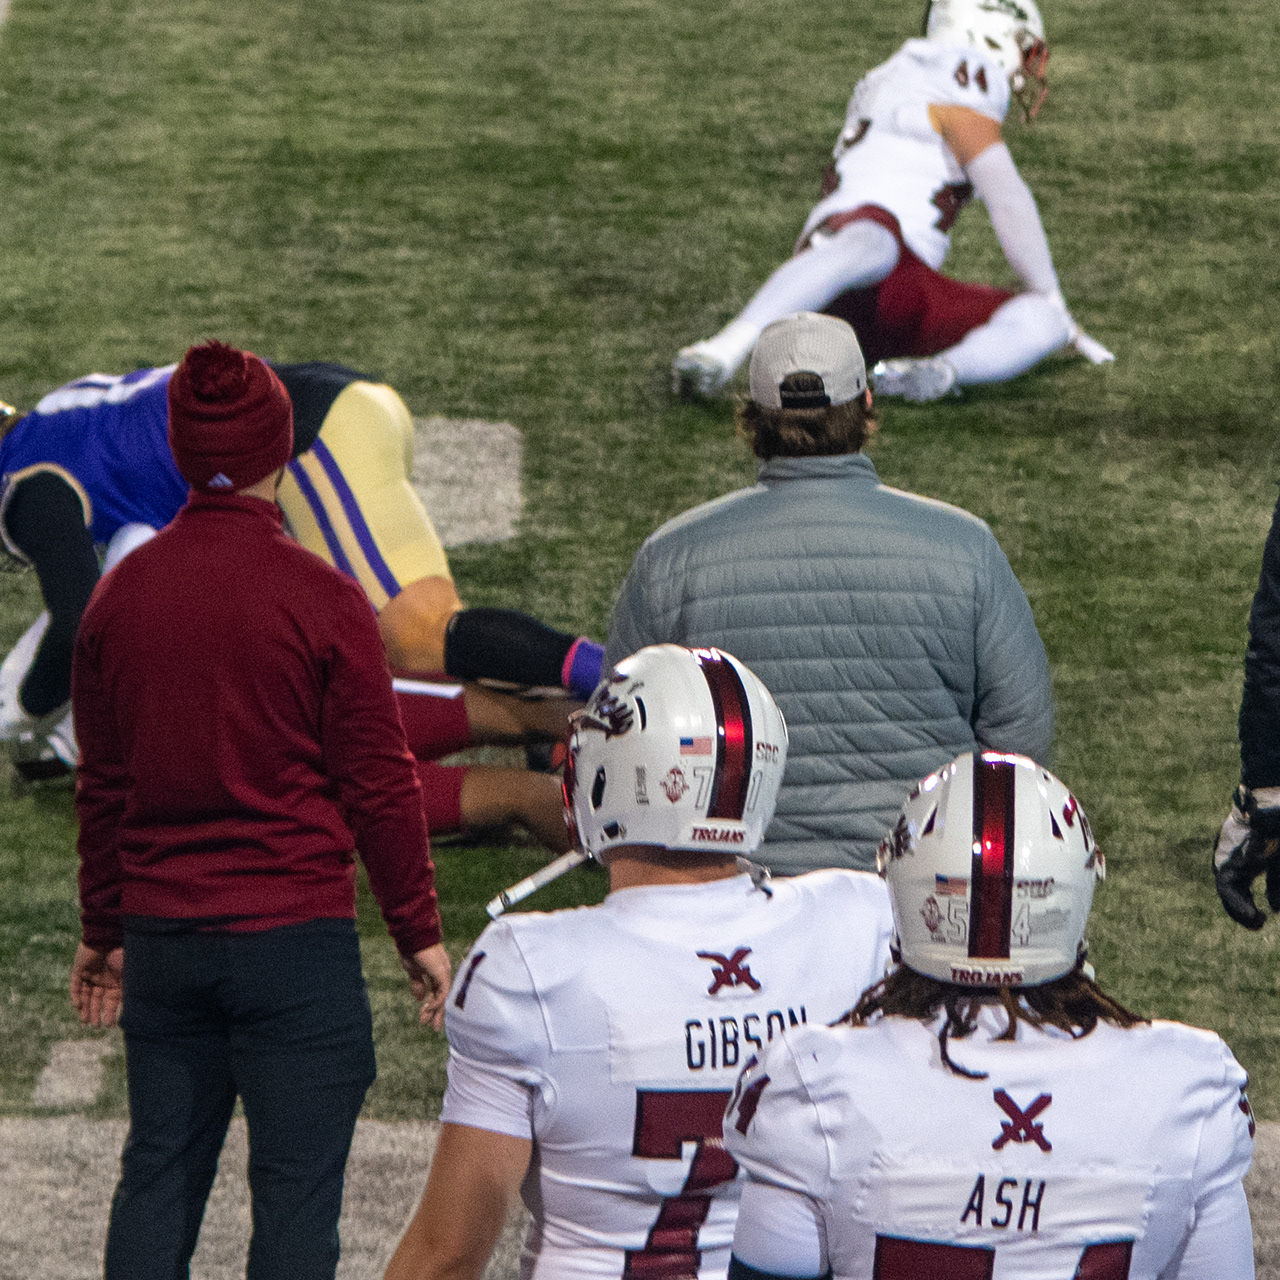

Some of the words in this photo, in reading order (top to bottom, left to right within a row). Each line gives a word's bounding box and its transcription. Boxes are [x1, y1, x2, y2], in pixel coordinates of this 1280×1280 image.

[691, 827, 746, 844] TROJANS
[951, 968, 1024, 986] TROJANS
[960, 1172, 1047, 1237] ASH
